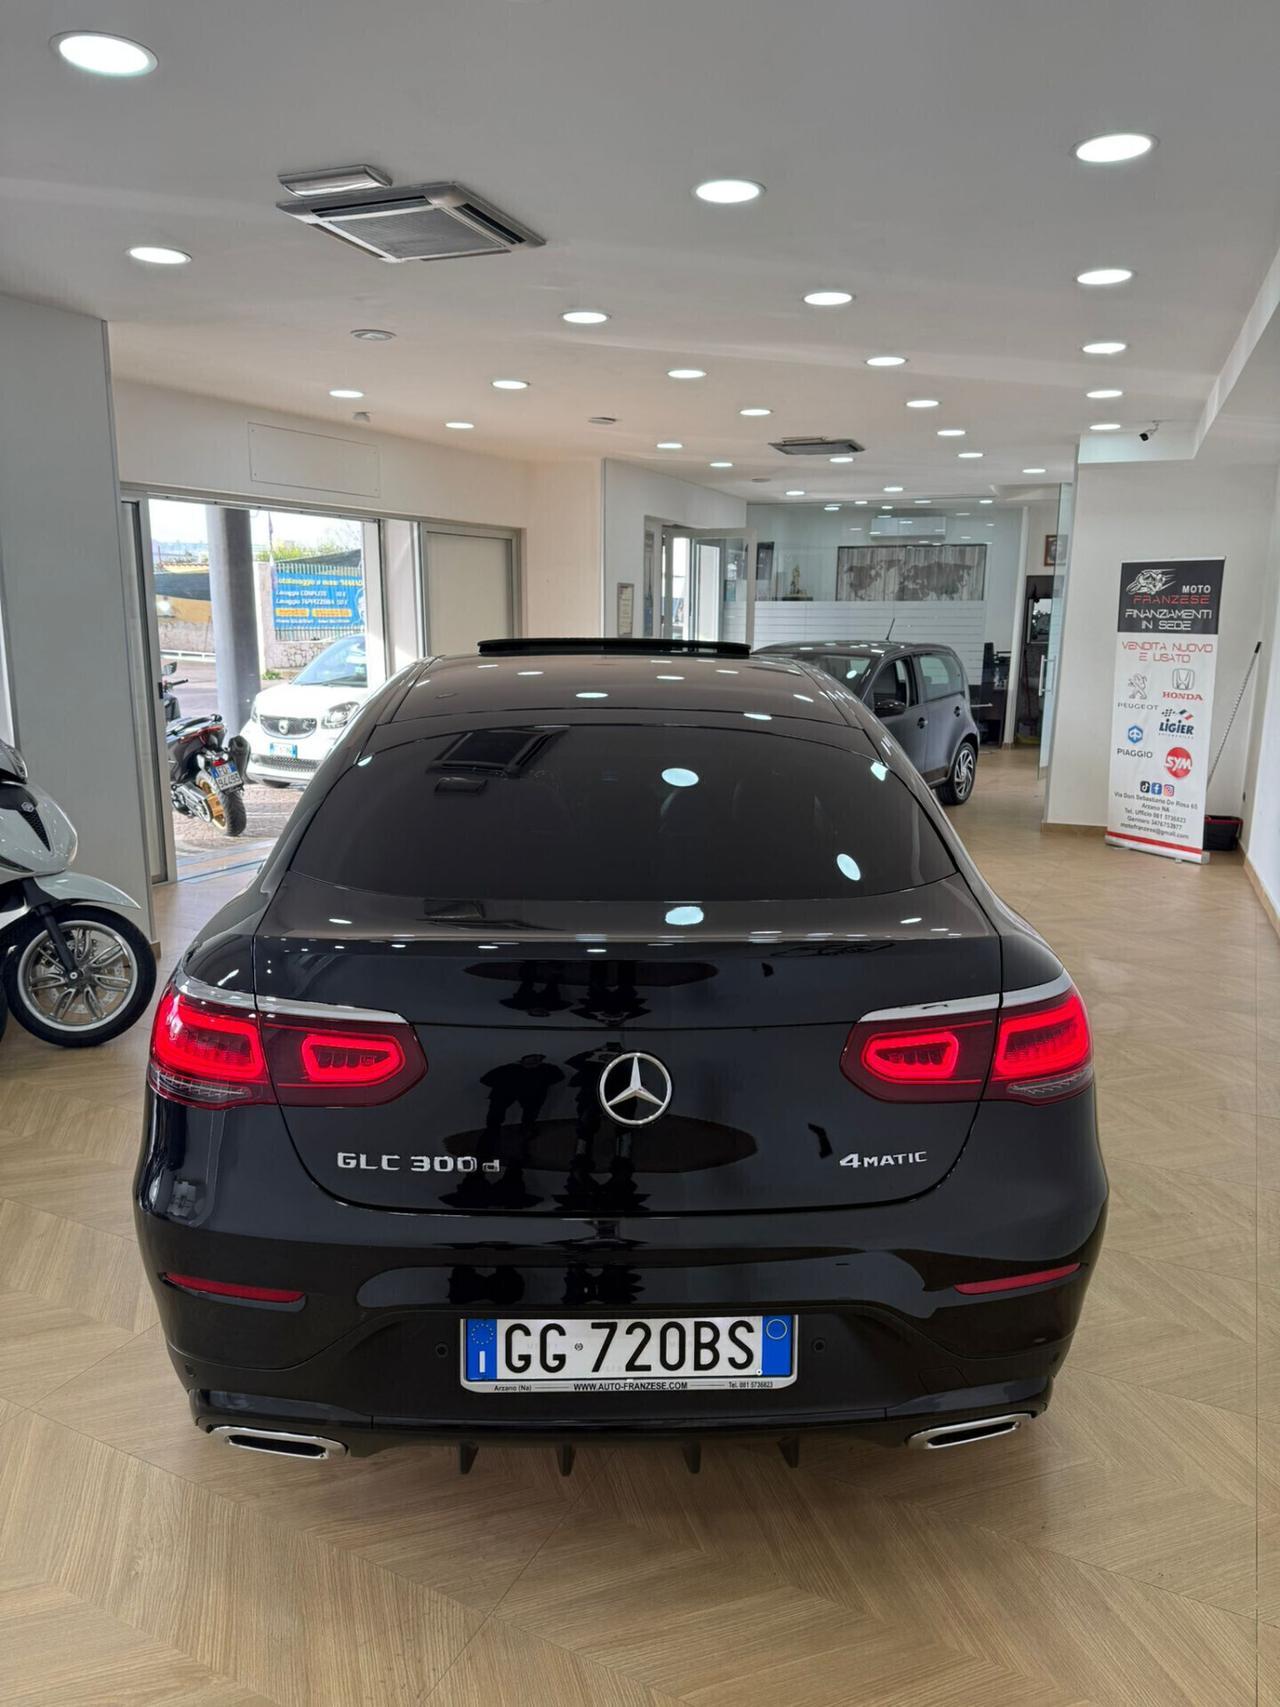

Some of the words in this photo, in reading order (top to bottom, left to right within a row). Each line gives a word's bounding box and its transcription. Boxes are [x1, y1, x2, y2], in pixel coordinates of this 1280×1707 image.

[1182, 585, 1211, 593] MOTO
[1133, 594, 1210, 605] FRANZESE
[1124, 608, 1212, 619] FINANZIAMENTI
[1141, 620, 1153, 629] IN
[1158, 620, 1191, 630] SEDE
[1121, 641, 1167, 651] VENDITA
[1172, 643, 1213, 653] NUOVO
[1139, 652, 1147, 661] E
[1153, 653, 1191, 664] USATO
[1162, 691, 1203, 701] HONDA
[1117, 702, 1159, 711] PEUGEOT
[1116, 748, 1153, 759] PIAGGIO
[1165, 756, 1192, 772] SYM
[337, 1152, 400, 1171] GLC
[839, 1151, 928, 1169] 4MATIC
[504, 1322, 567, 1374] GG
[590, 1319, 755, 1374] 720BS
[494, 1384, 517, 1392] Arzano
[518, 1384, 532, 1392] (Na)
[573, 1381, 688, 1392] WWW.AUTO-FRANZESE.COM
